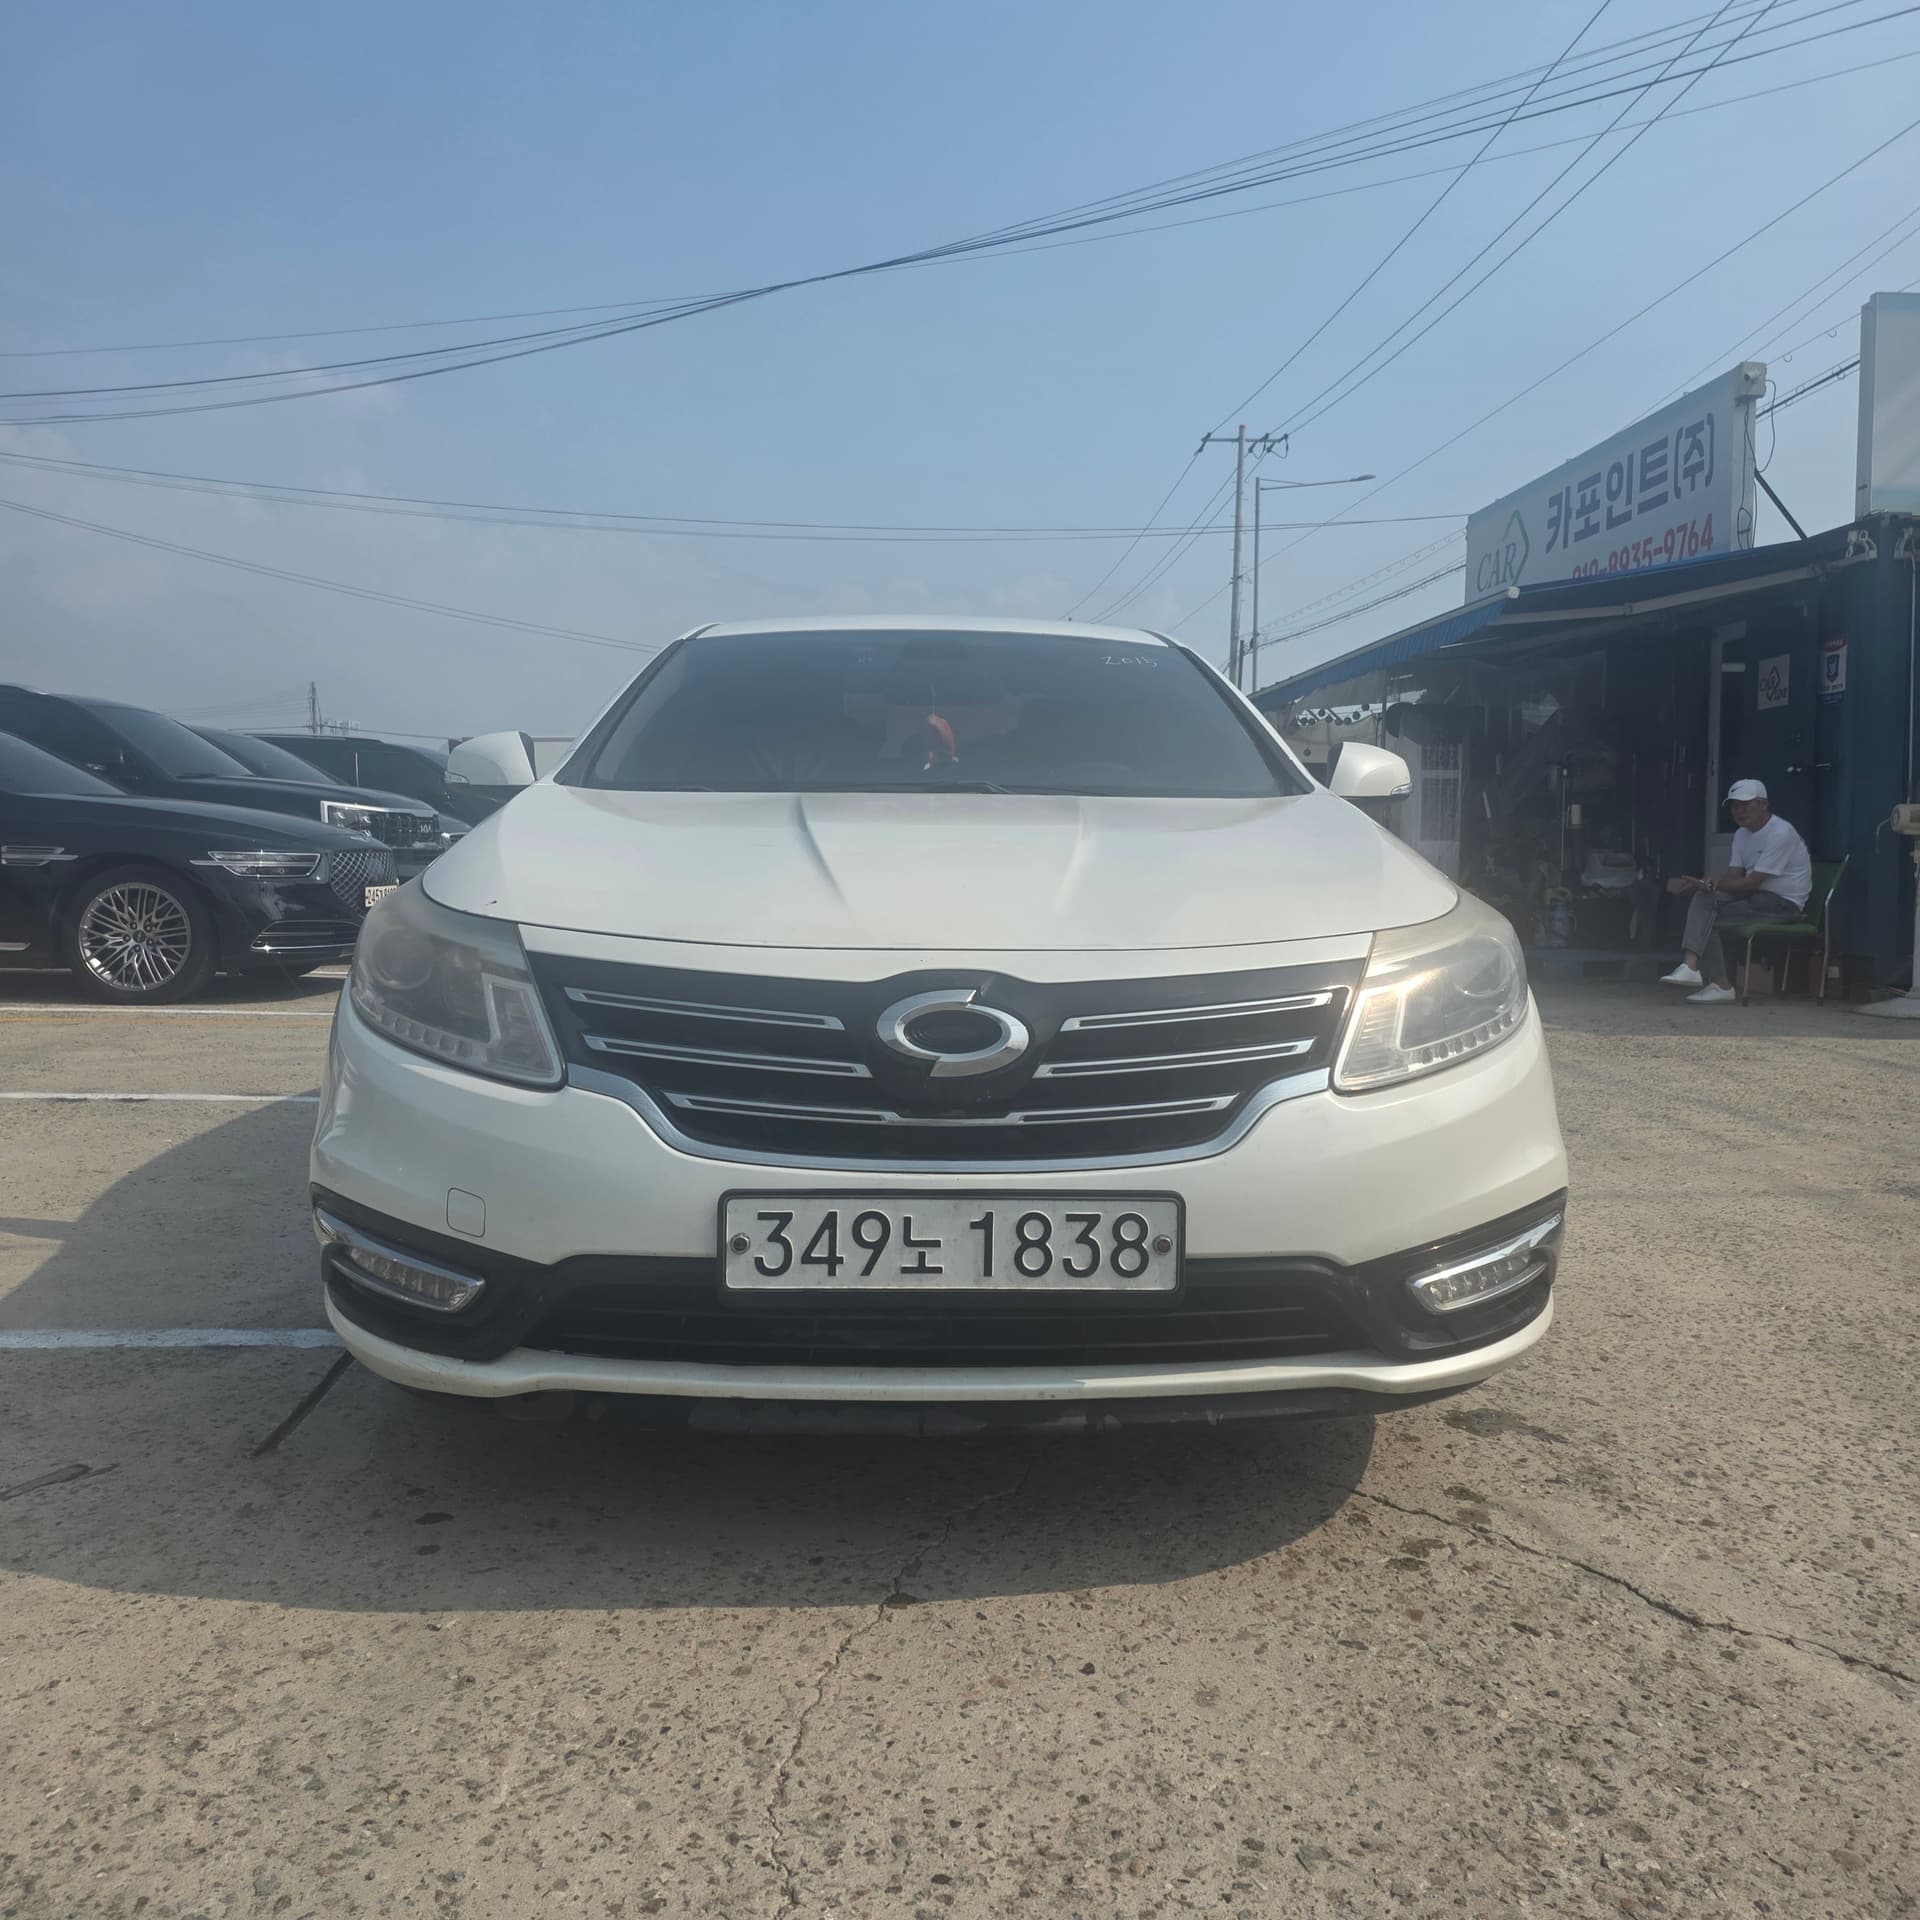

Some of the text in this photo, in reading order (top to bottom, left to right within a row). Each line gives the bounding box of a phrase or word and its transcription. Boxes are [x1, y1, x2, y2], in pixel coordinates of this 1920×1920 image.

[1545, 413, 1714, 554] 카포인트(주)
[1477, 542, 1516, 592] CAR
[754, 1209, 1150, 1277] 349노 1838
